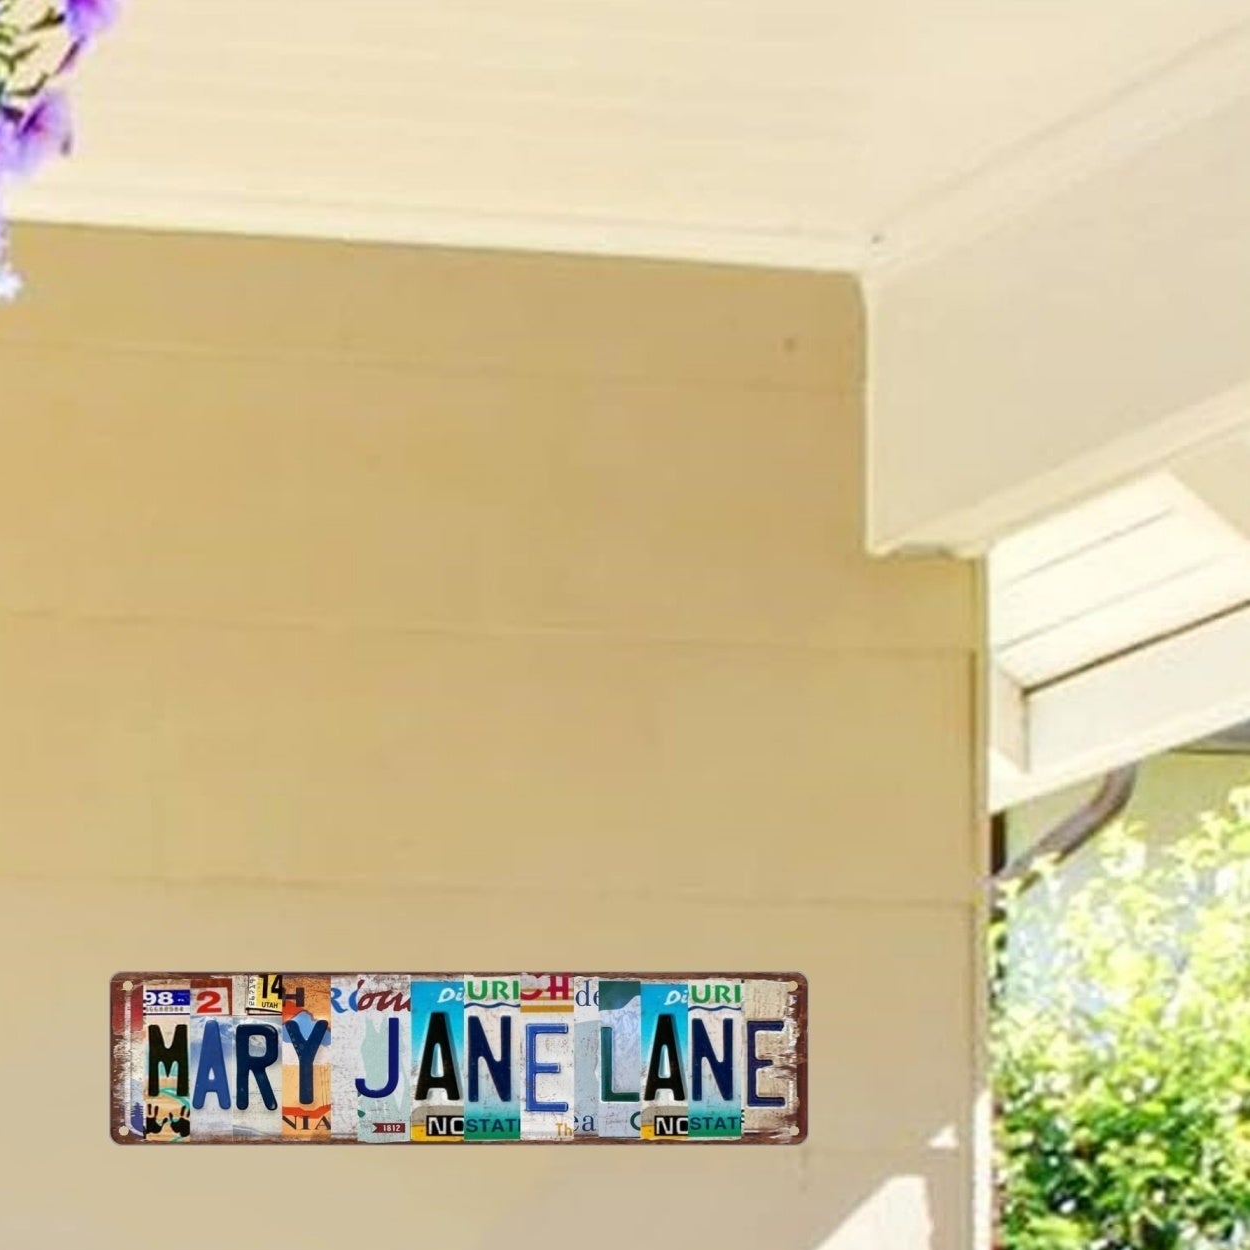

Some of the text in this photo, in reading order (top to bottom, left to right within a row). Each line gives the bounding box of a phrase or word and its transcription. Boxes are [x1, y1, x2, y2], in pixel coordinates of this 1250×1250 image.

[467, 980, 519, 1001] URI
[691, 984, 741, 1004] URI
[196, 990, 222, 1014] 2
[261, 1001, 279, 1009] UTAH
[147, 1011, 786, 1113] MARY JANE LANE
[383, 1124, 401, 1132] 1812
[466, 1118, 520, 1133] STAT
[690, 1116, 742, 1130] STAT
